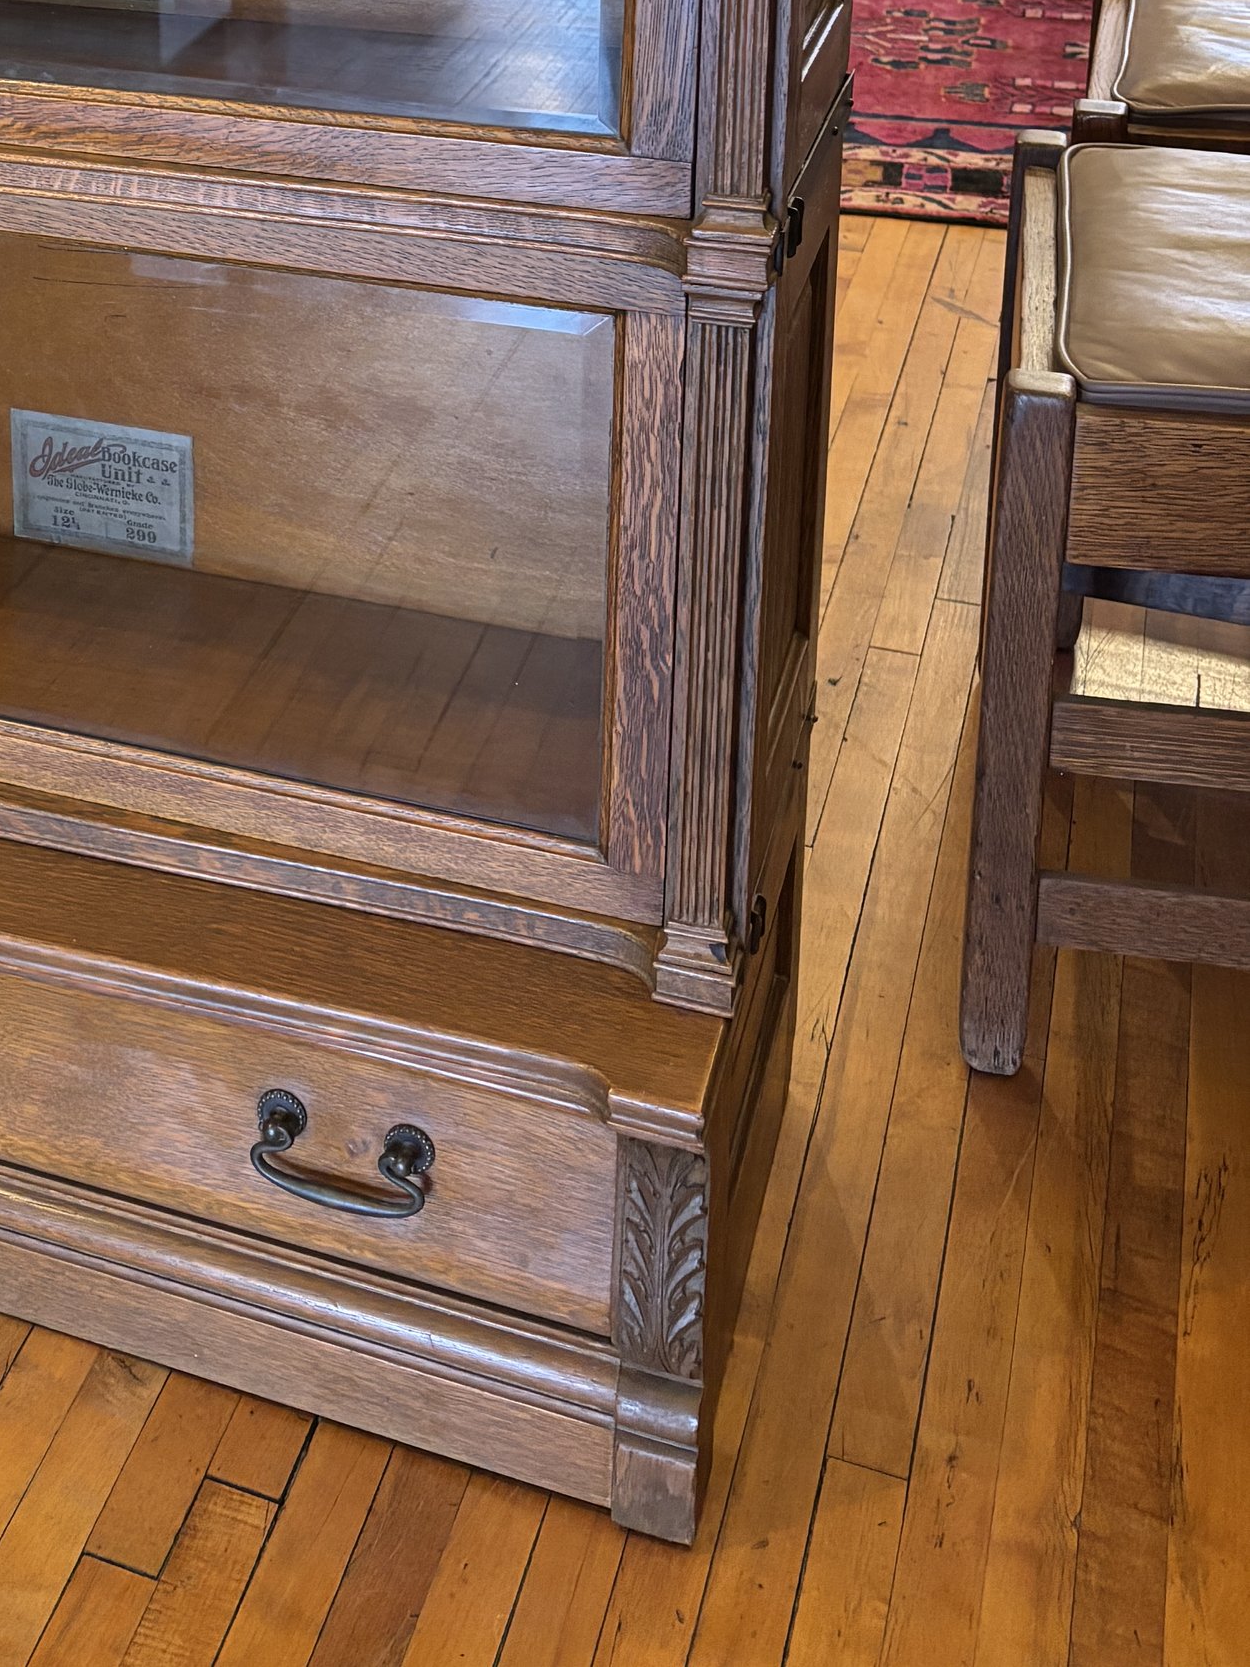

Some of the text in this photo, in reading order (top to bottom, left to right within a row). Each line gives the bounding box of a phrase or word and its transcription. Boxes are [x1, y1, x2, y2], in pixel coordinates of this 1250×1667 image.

[29, 436, 178, 480] Ideal Bookcase
[101, 463, 143, 484] Unit
[47, 474, 64, 488] The
[145, 491, 162, 505] Co.
[53, 506, 75, 516] Size
[126, 527, 157, 544] 299
